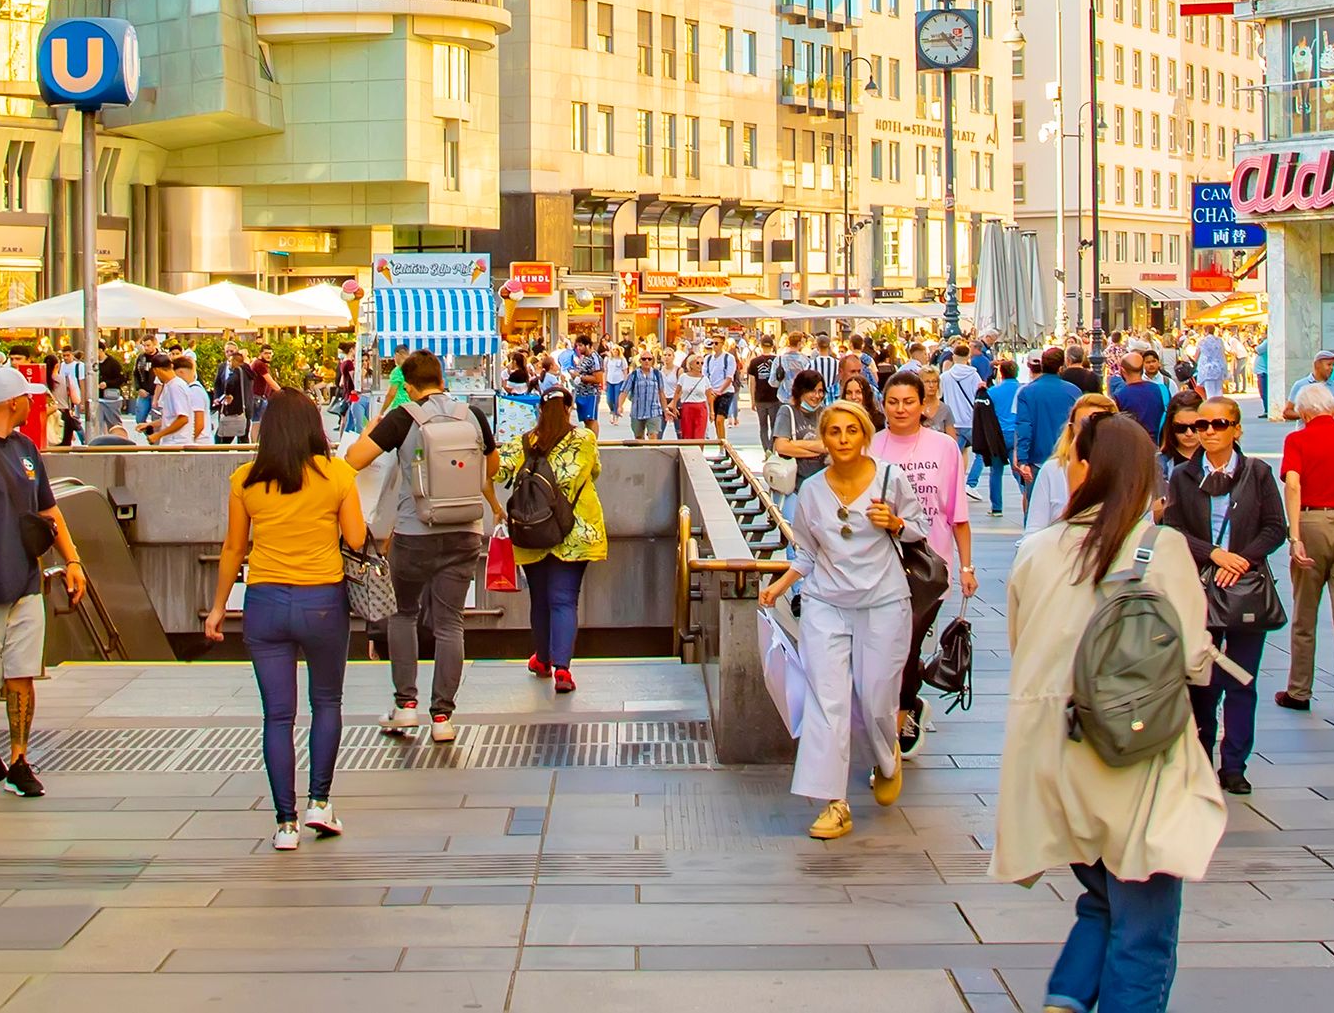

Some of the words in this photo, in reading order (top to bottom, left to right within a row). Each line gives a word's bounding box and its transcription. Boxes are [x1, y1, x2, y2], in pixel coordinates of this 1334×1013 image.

[51, 37, 104, 94] U
[875, 118, 902, 134] HOTEL
[514, 275, 551, 283] HEINDL
[647, 275, 677, 288] SOUVENIRS
[681, 275, 731, 288] SOUVENIRS
[899, 461, 938, 471] NCIAGA
